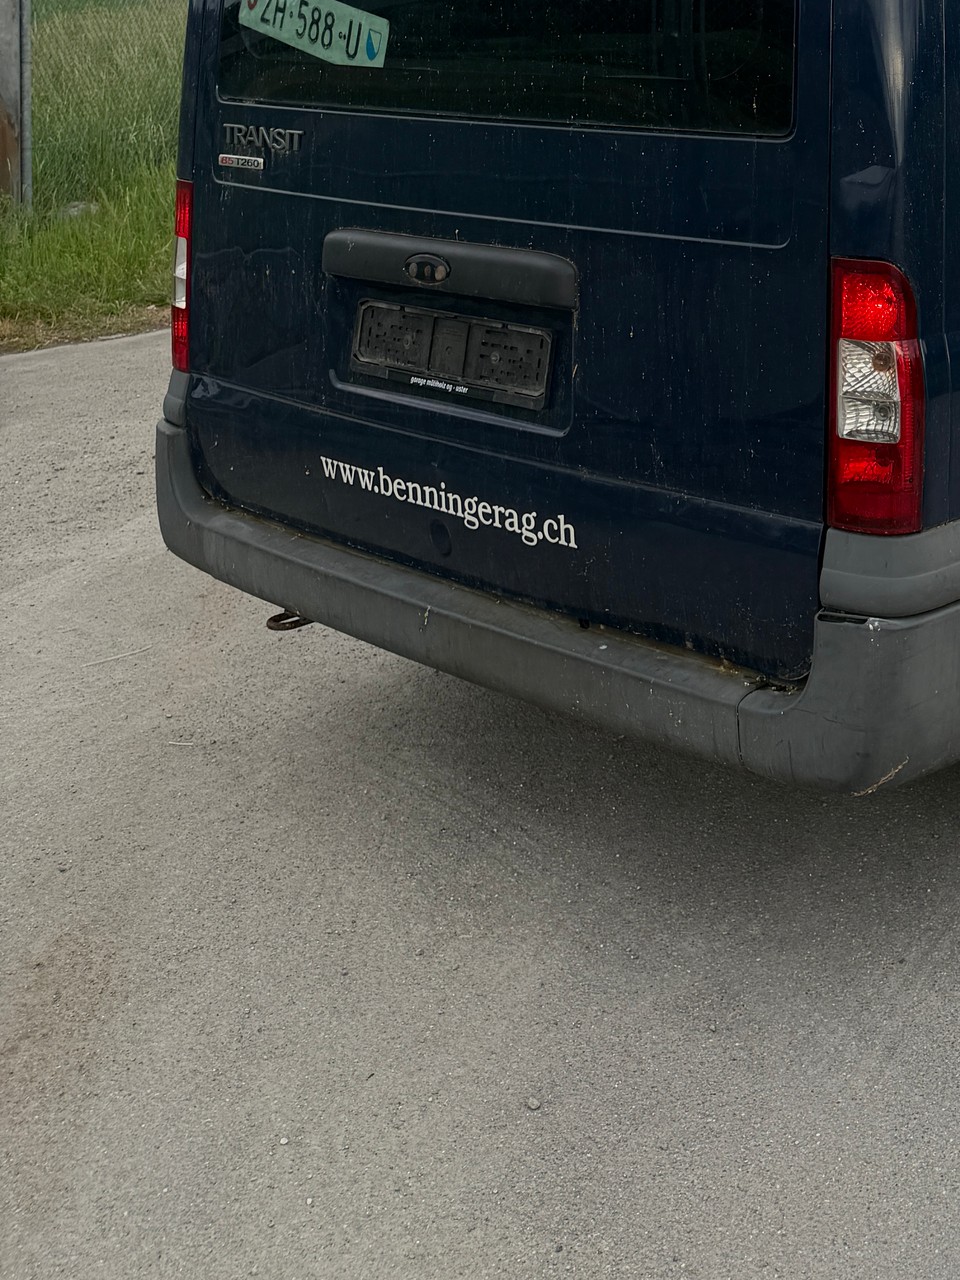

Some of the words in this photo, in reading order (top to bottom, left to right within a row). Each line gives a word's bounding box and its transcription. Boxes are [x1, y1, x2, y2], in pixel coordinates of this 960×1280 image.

[222, 123, 305, 151] TRANSIT
[235, 157, 260, 168] T260
[320, 455, 578, 549] www.benningerag.ch
